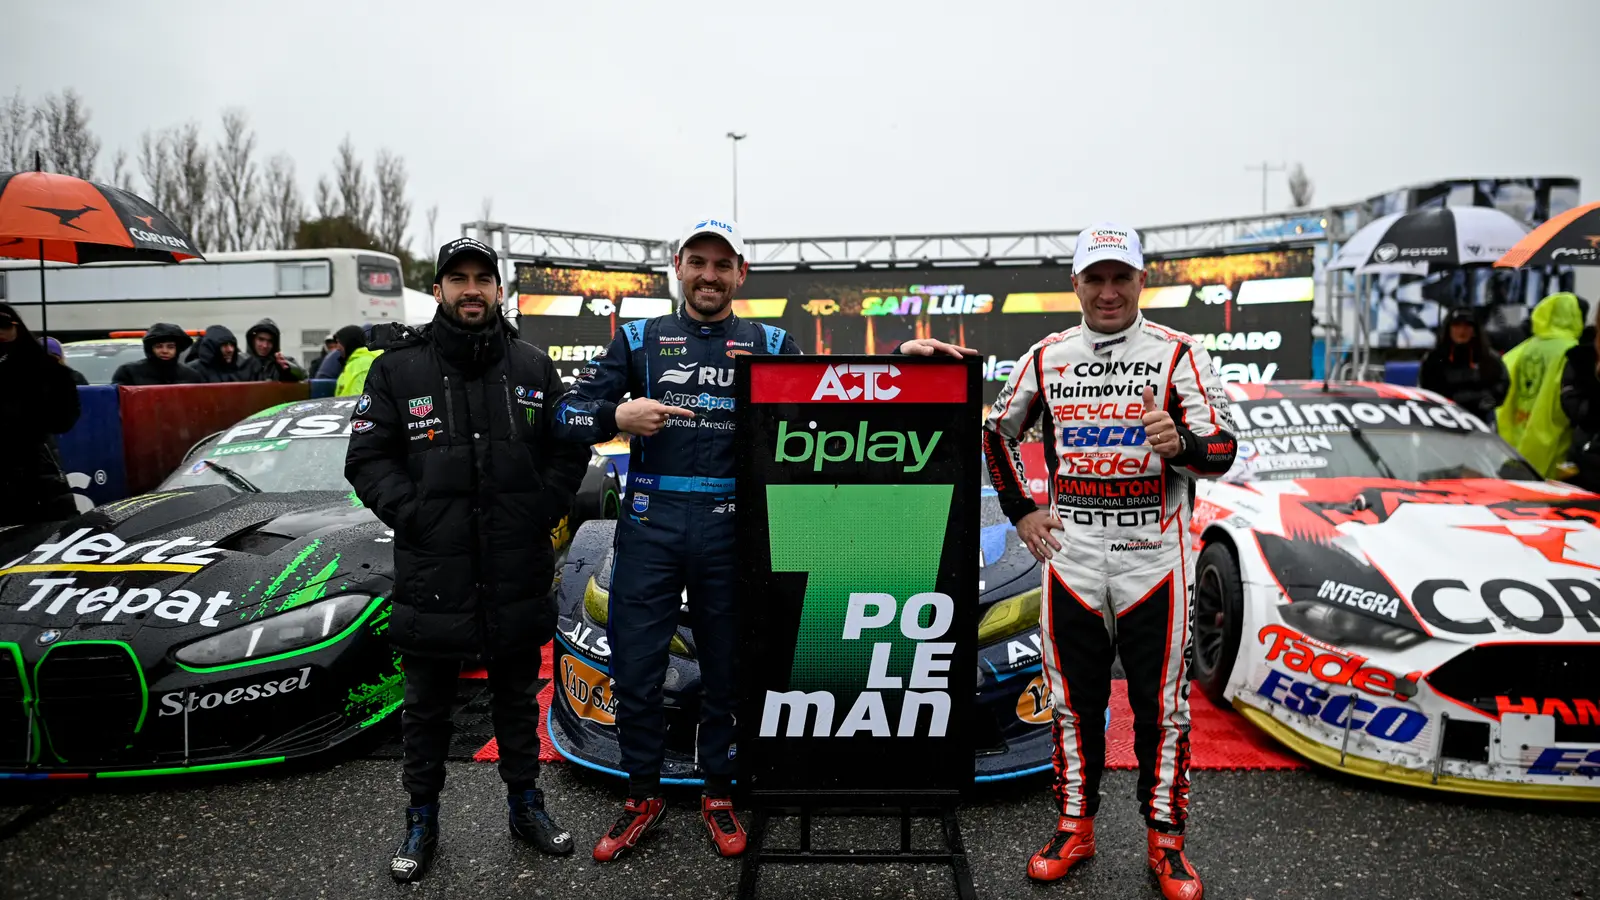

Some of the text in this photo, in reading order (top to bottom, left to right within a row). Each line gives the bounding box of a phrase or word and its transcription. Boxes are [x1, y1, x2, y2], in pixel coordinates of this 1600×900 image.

[710, 219, 733, 233] RUS
[129, 227, 190, 250] CORVEN
[927, 294, 994, 315] LUIS
[659, 347, 681, 356] ALS
[698, 366, 735, 387] RU
[1073, 361, 1162, 378] CORVEN
[810, 363, 902, 401] ACTC
[410, 397, 430, 406] TAG
[1053, 402, 1150, 422] RECYCLE
[217, 414, 352, 445] FIS
[408, 417, 442, 429] FISPA
[575, 416, 594, 426] RUS
[663, 416, 696, 428] grícola
[1062, 426, 1147, 447] ESCO
[1236, 433, 1333, 458] ORVEN
[213, 444, 261, 456] Lucas
[1062, 452, 1151, 476] Tadel
[1058, 479, 1160, 497] HAMILTON
[1058, 494, 1160, 506] PROFESSIONAL BRAND
[1058, 507, 1160, 527] FOTON
[17, 578, 233, 627] Trepat
[1317, 580, 1400, 618] INTEGRA
[841, 592, 954, 640] PO
[564, 621, 612, 656] ALS
[866, 642, 957, 689] LE
[563, 658, 589, 704] YAD
[158, 667, 312, 717] Stoessel
[1257, 668, 1430, 743] ESCO
